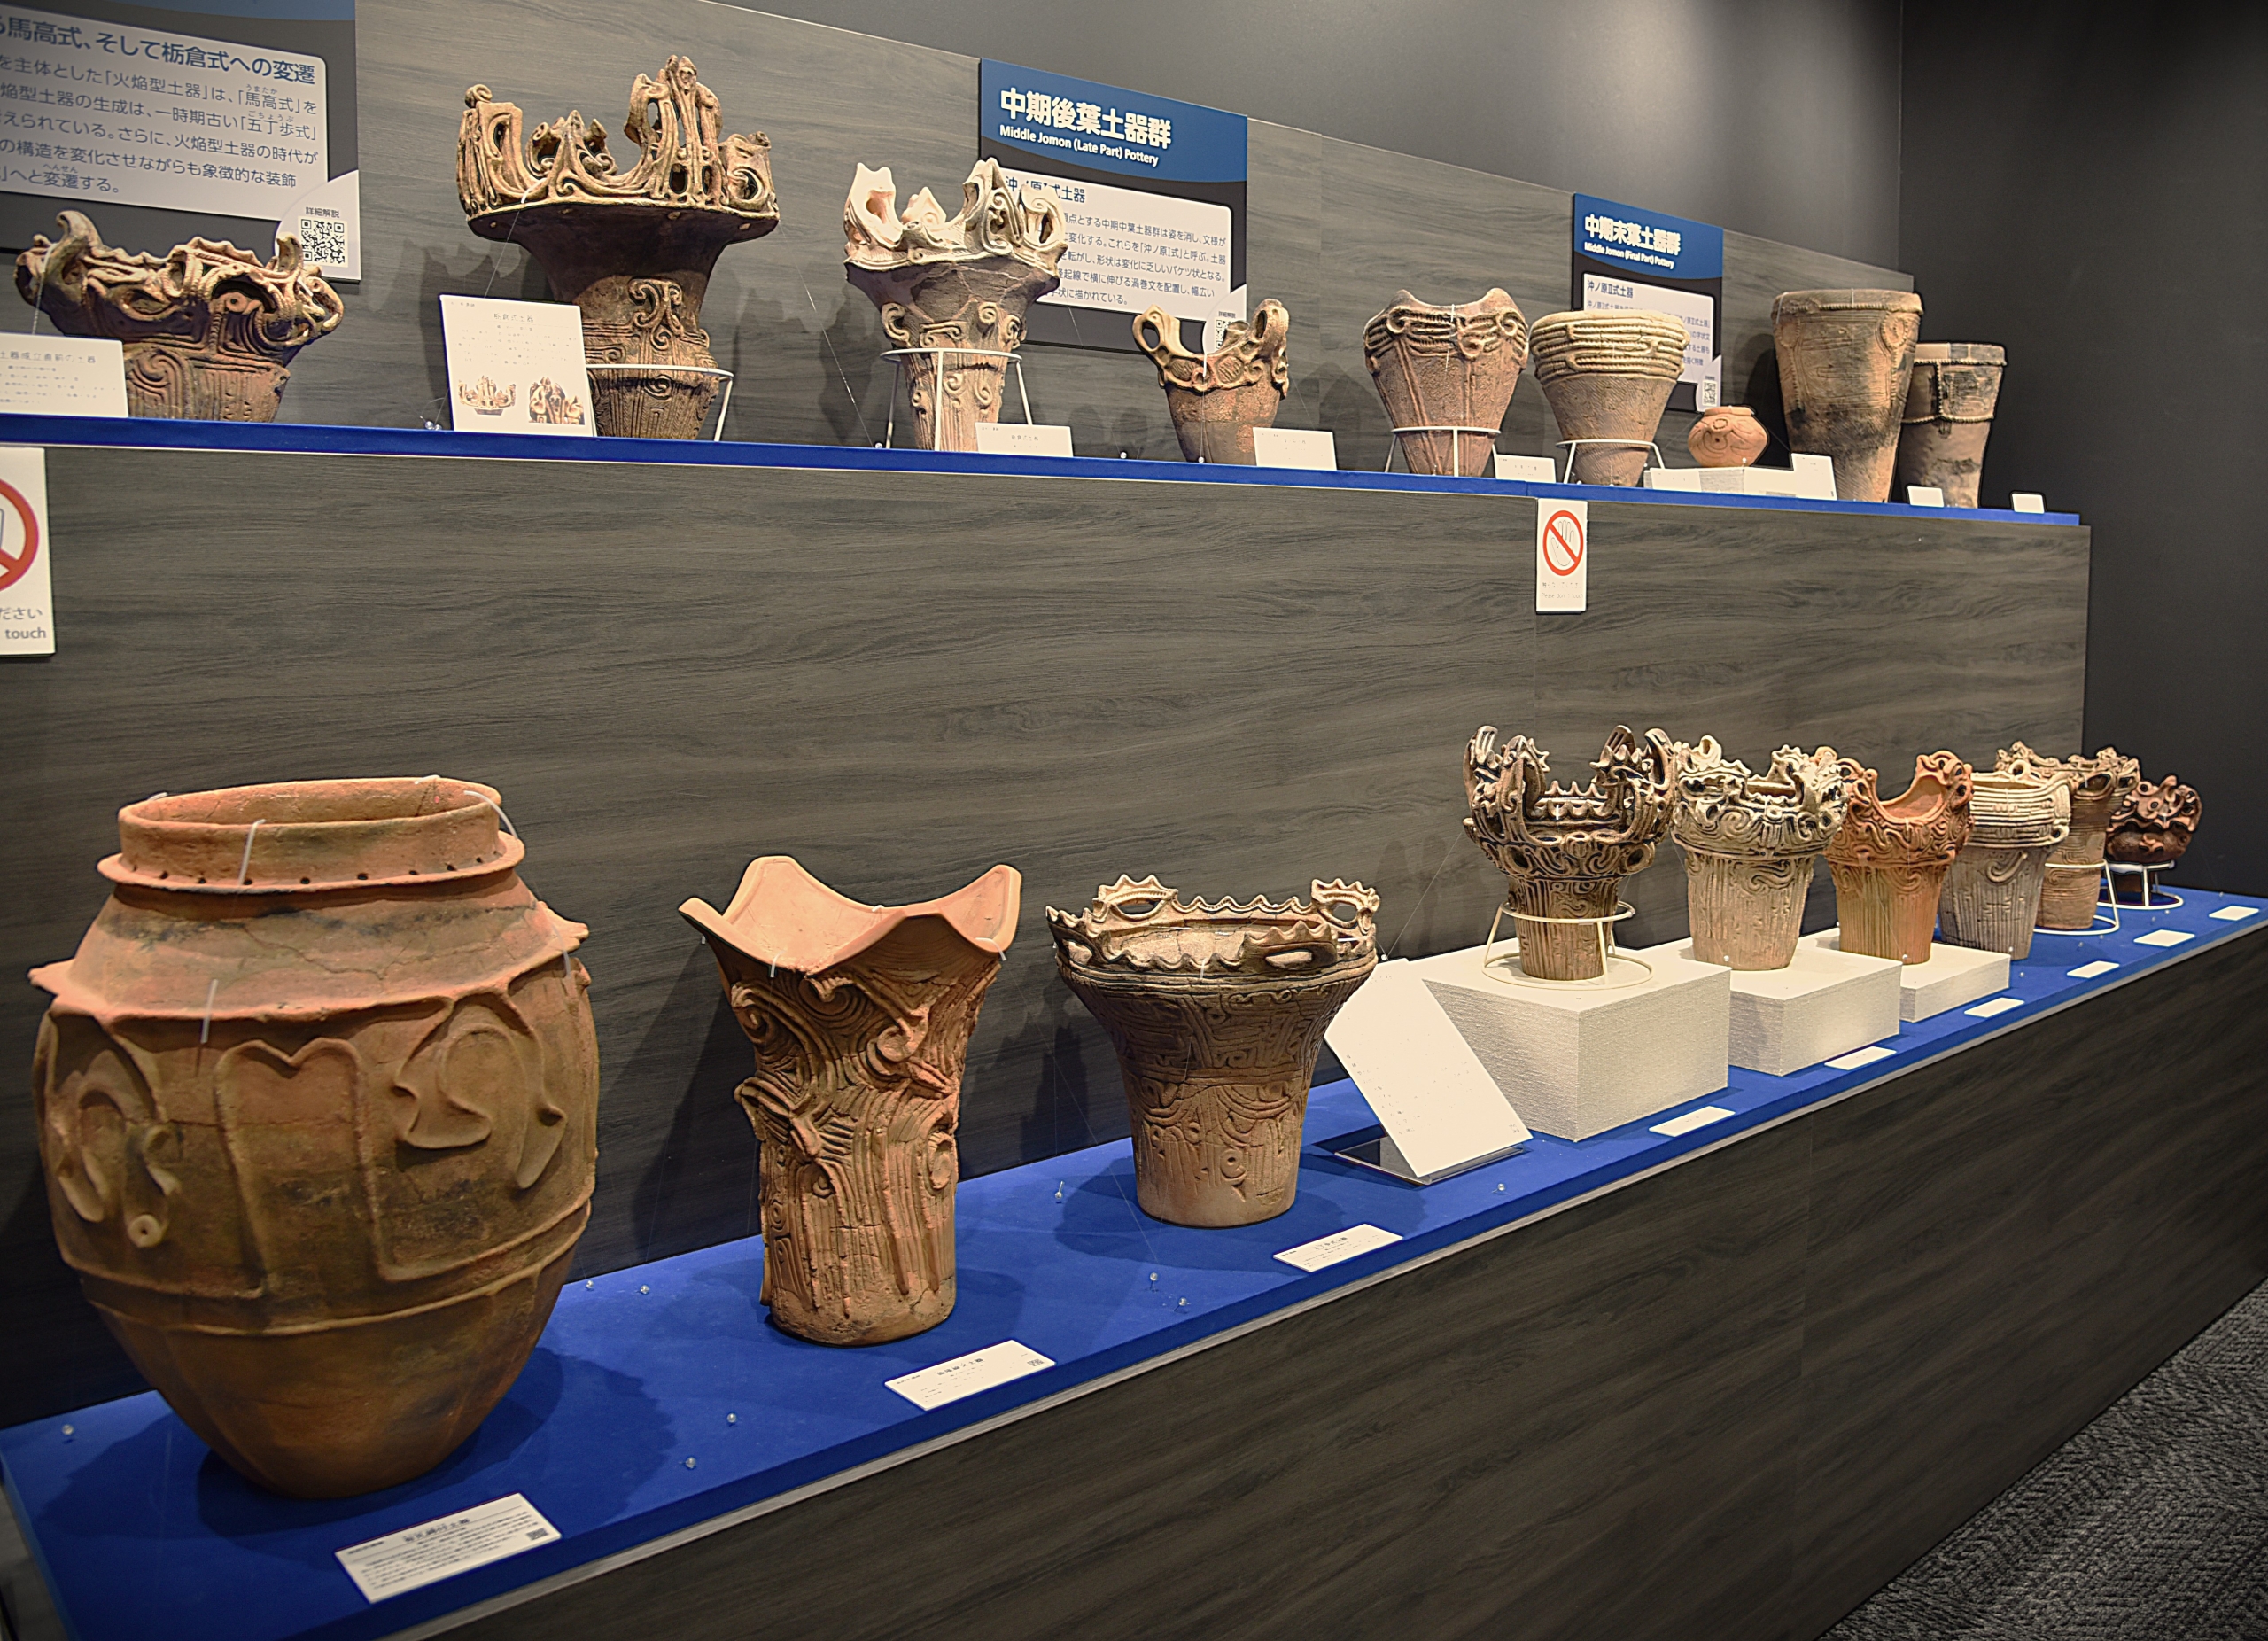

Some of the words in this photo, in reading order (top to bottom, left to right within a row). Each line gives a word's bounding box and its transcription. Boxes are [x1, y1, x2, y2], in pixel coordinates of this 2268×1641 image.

[0, 110, 318, 165] えられている。さらに、火焔型土器の時代が
[1000, 87, 1171, 150] 中期後葉土器群
[1000, 125, 1037, 142] Middle
[1038, 131, 1072, 149] Jomon
[1074, 138, 1098, 154] (Late
[1100, 144, 1122, 159] Part)
[1125, 149, 1159, 167] Pottery
[0, 165, 120, 193] 」へと変遷する。
[1585, 214, 1681, 255] 中期末葉土器群
[1584, 242, 1605, 253] Middle
[1605, 246, 1625, 257] Jomon
[1655, 256, 1674, 269] Pottery
[5, 627, 47, 639] touch
